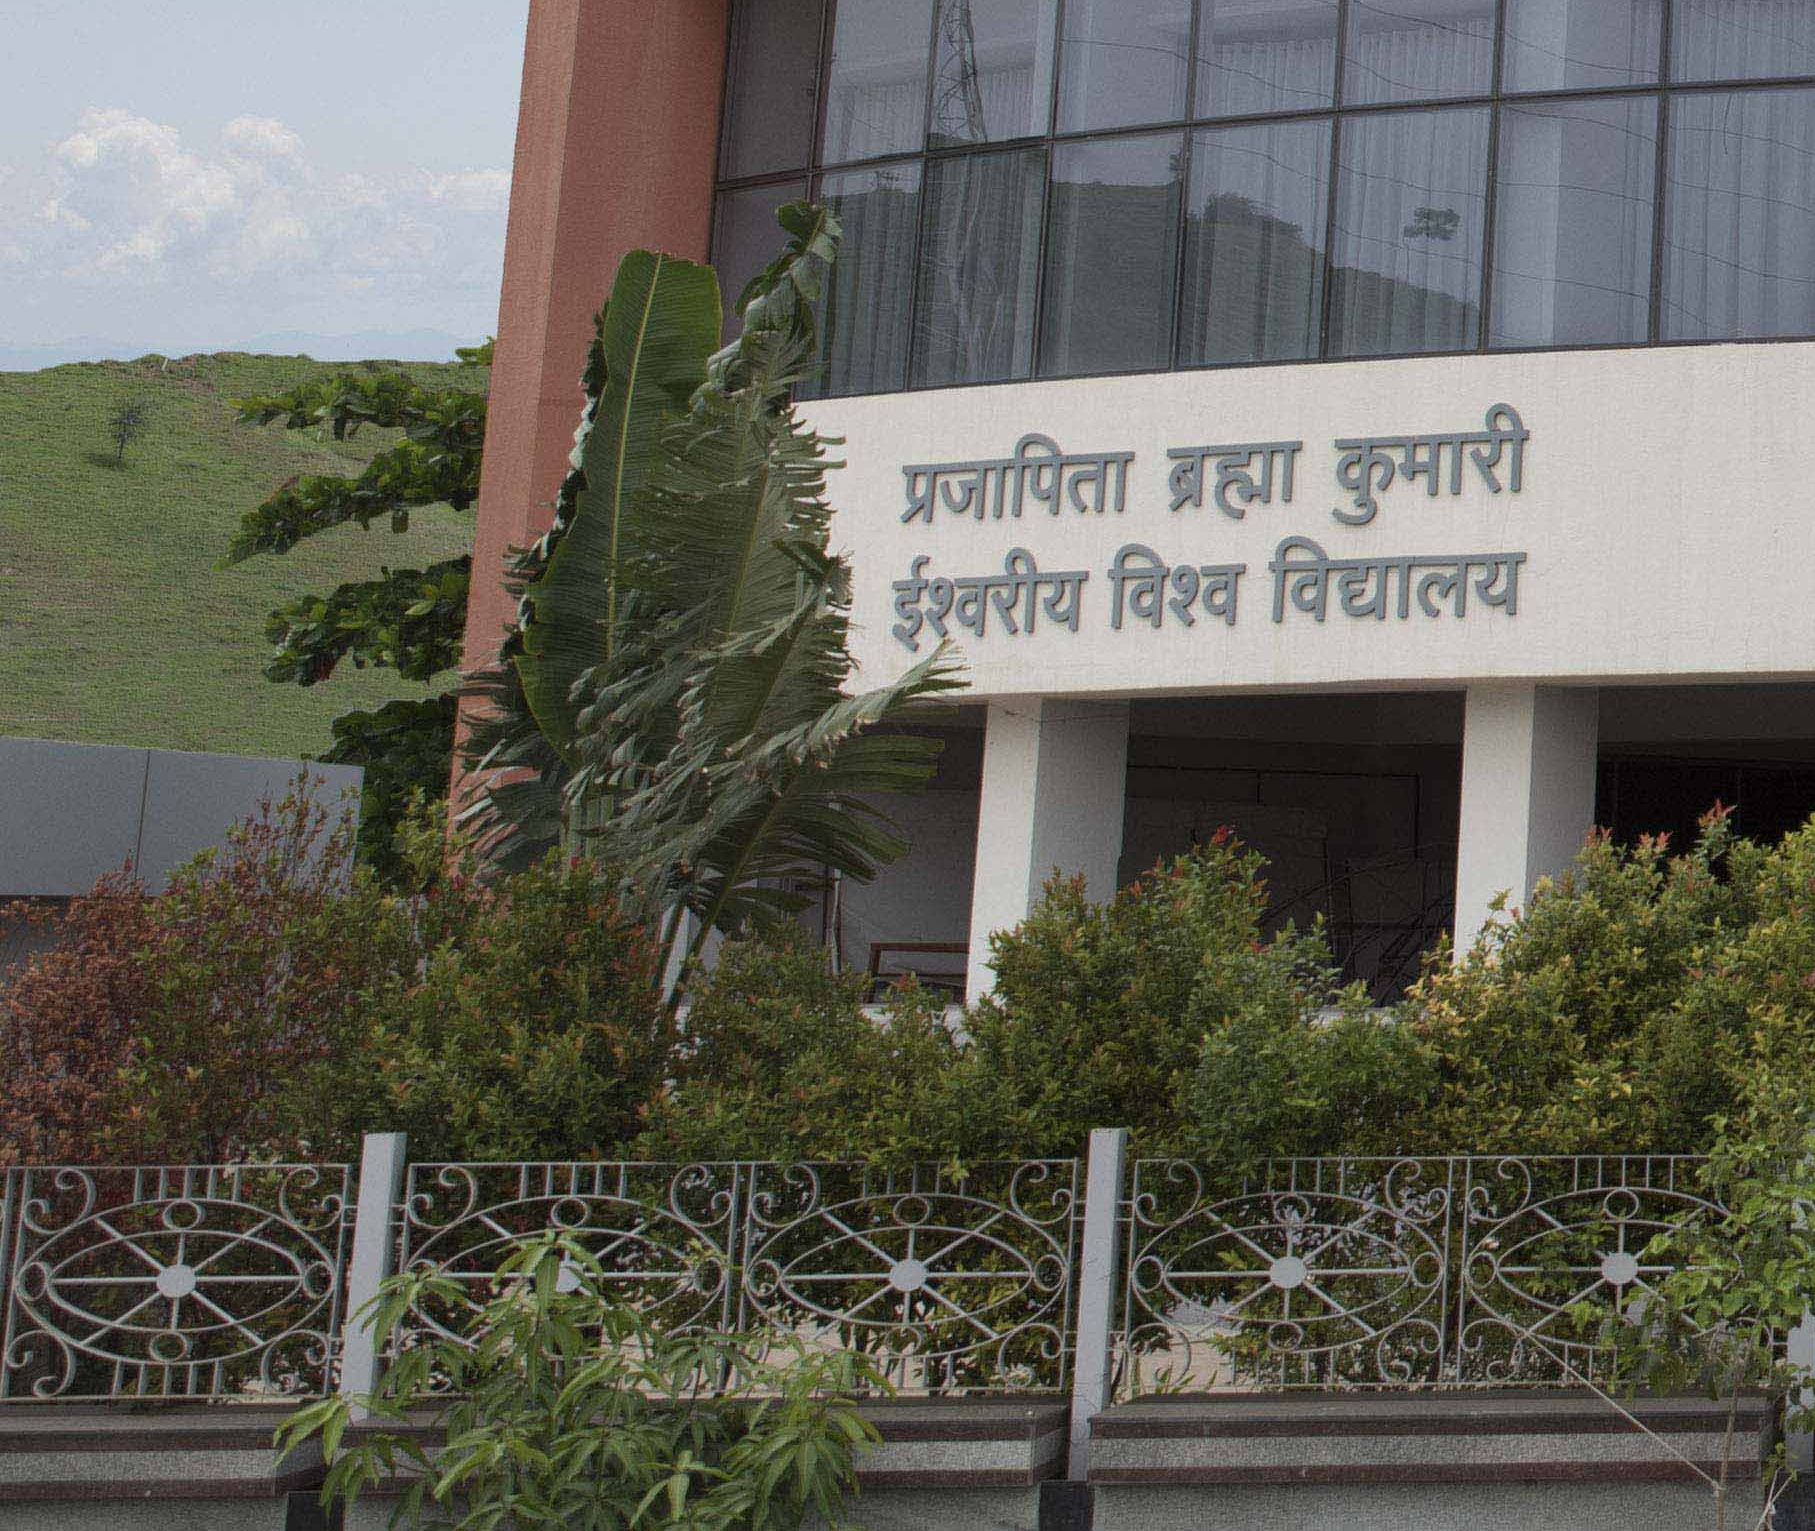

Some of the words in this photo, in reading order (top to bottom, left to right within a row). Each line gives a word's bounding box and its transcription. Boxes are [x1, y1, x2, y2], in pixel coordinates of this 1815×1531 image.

[900, 432, 1136, 524] प्रजापिता
[1166, 440, 1304, 520] ब्रह्मा
[1331, 402, 1531, 527] कुमारी
[891, 546, 1090, 652] ईश्वरीय
[1107, 543, 1247, 631] विश्व
[1267, 535, 1528, 625] विद्यालय
